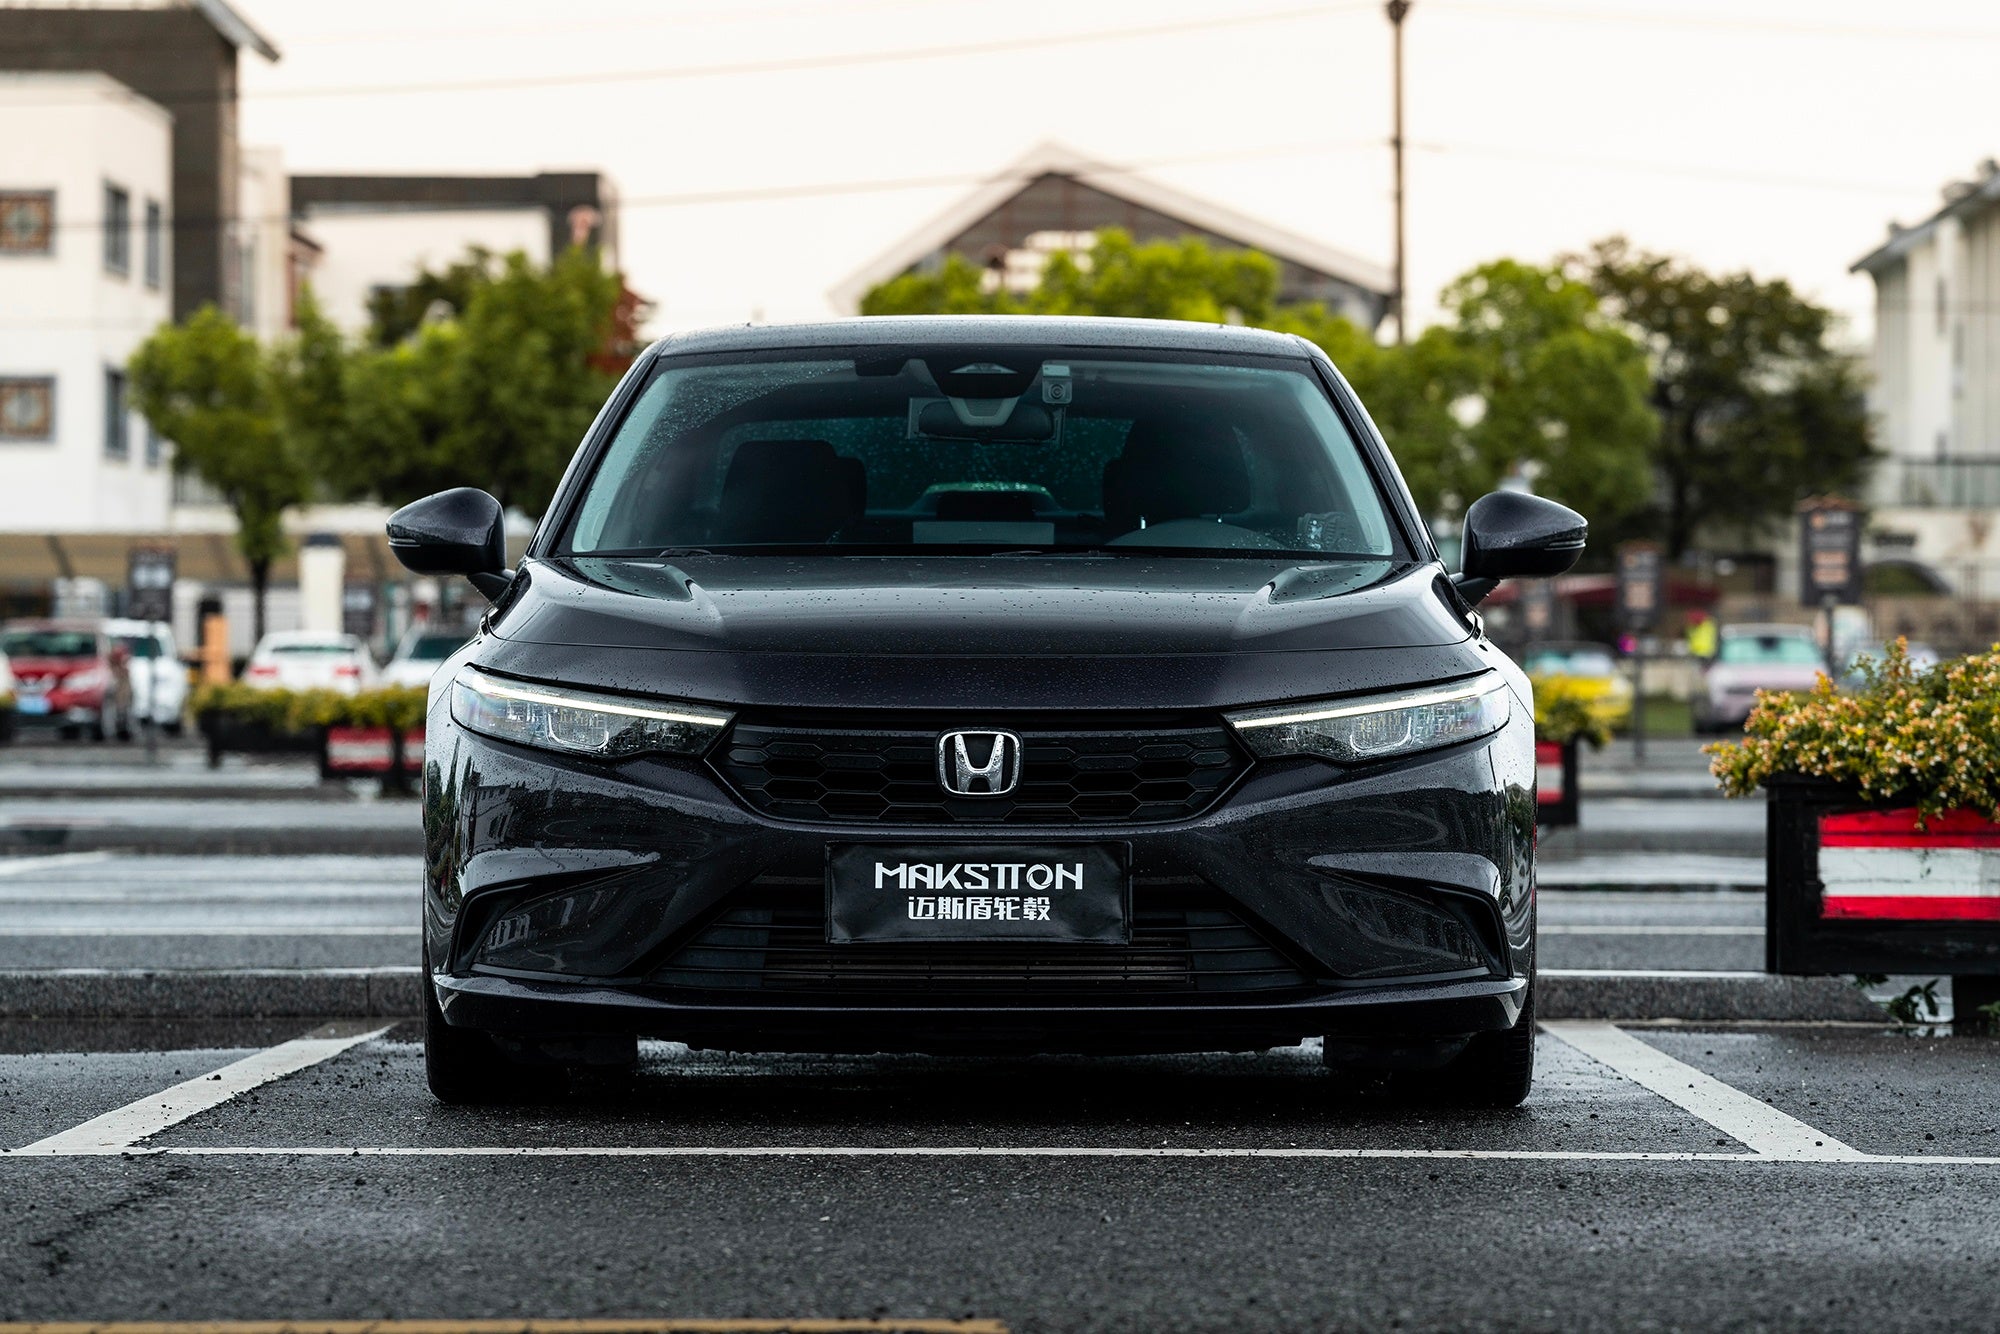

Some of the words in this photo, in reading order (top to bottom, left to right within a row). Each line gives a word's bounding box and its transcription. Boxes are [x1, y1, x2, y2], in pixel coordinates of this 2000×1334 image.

[907, 896, 1051, 921] 迈斯盾轮毂
